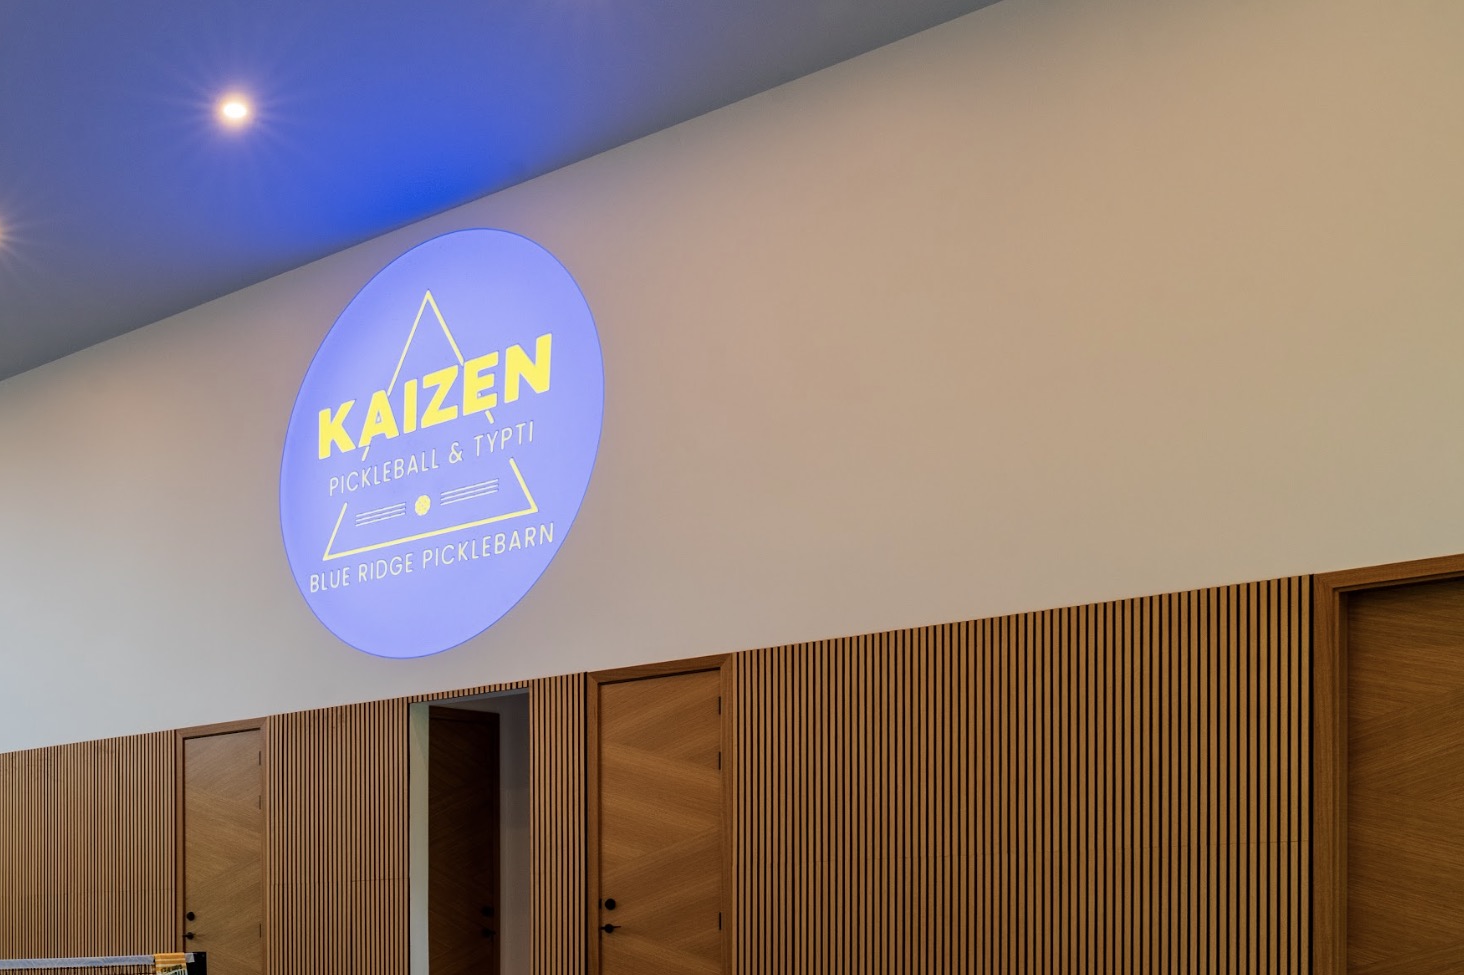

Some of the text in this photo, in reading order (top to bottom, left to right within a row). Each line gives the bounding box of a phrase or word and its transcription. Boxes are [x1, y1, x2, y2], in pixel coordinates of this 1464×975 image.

[318, 333, 553, 460] KAIZEN
[329, 420, 534, 497] PICKLEBALL & TYPTI
[309, 522, 555, 593] BLUE RIDGE PICKLEBARN
